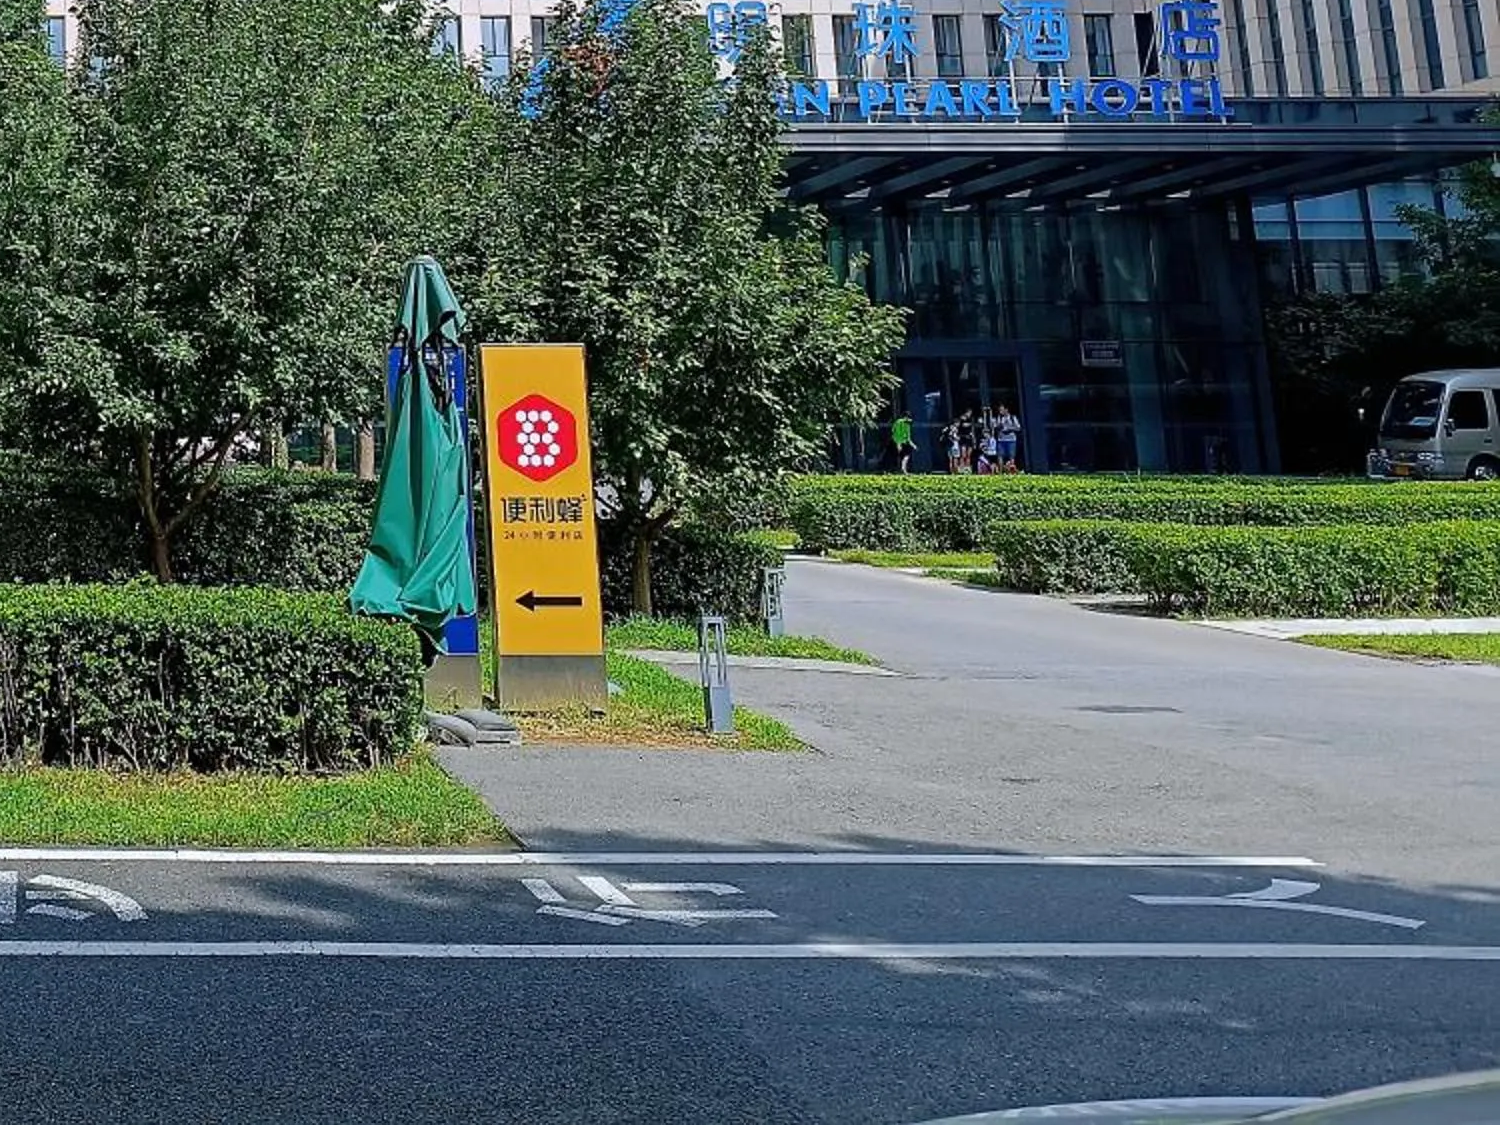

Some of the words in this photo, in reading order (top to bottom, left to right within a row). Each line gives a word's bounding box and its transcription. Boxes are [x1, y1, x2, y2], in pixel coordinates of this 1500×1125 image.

[857, 80, 1021, 116] PEARL
[1049, 78, 1235, 116] HOTEL
[500, 496, 583, 523] 便利蜂
